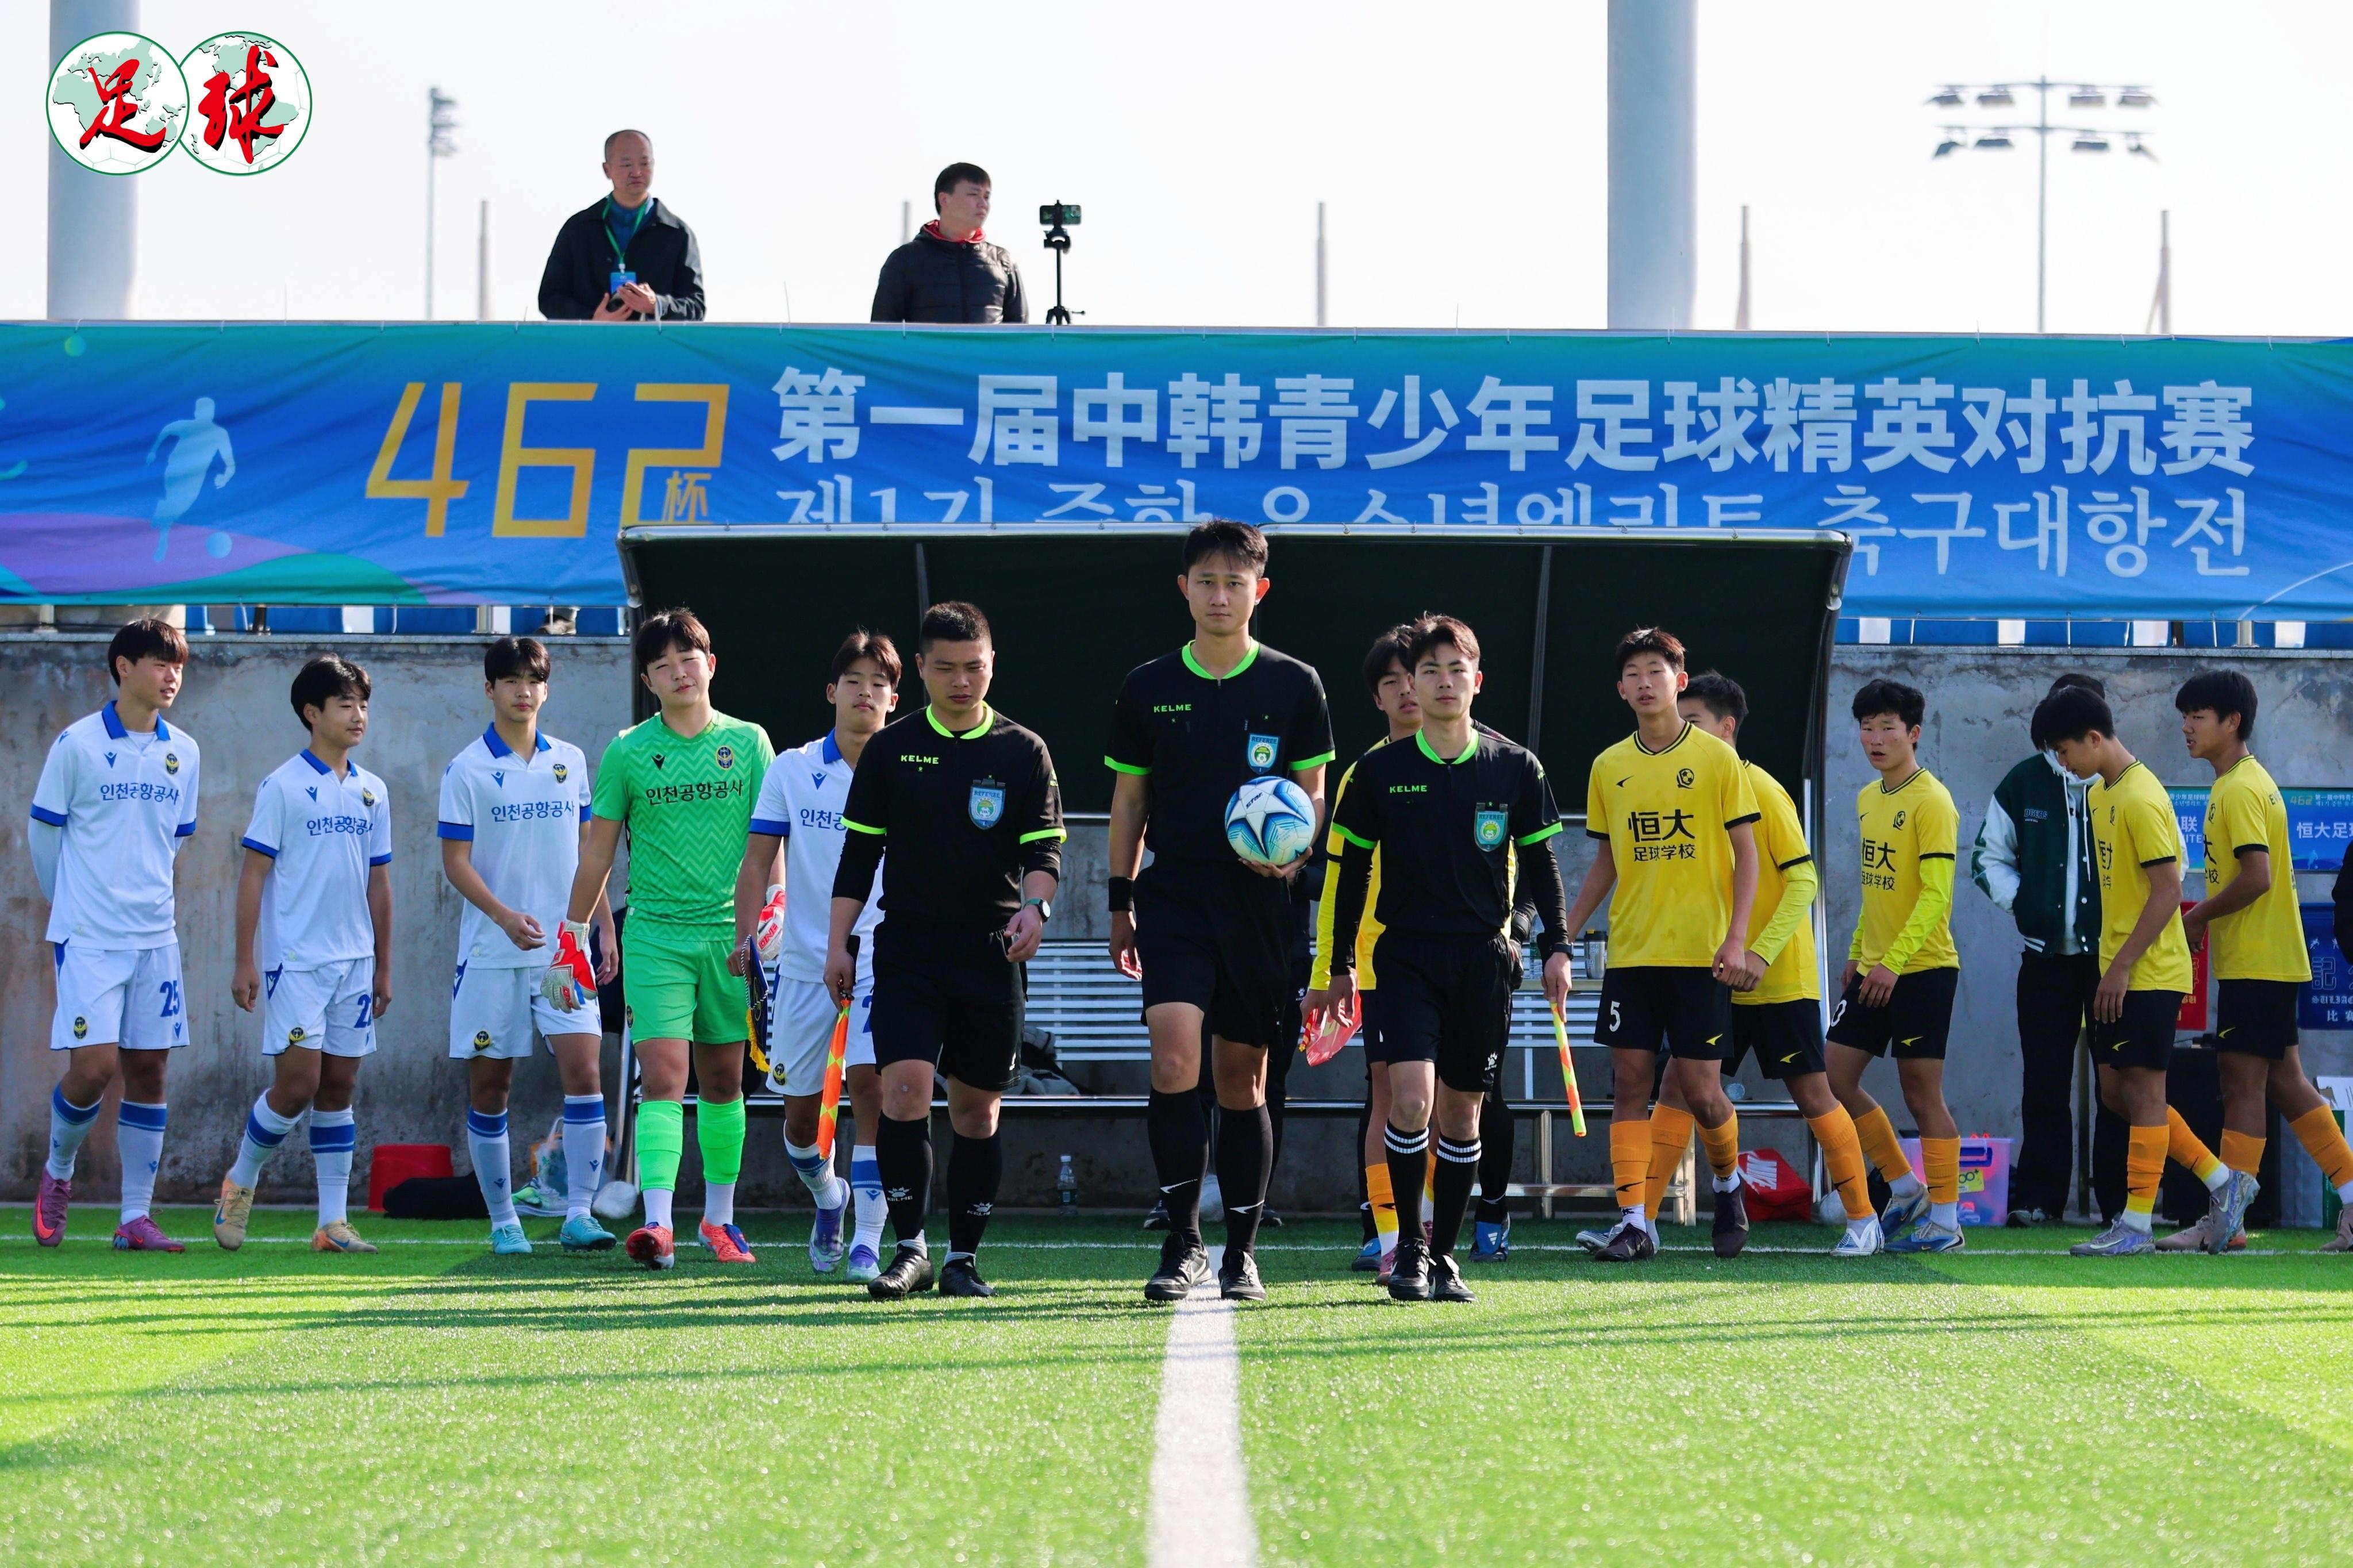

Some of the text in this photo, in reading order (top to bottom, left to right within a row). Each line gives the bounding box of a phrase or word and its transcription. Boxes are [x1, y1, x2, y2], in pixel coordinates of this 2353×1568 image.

[771, 366, 2255, 477] 第一届中韩青少年足球精英对抗赛
[366, 383, 730, 539] 462
[1154, 704, 1191, 713] KELME
[901, 754, 939, 764] KELME
[100, 782, 179, 805] 인천공항공사
[645, 779, 743, 805] 인천공항공사
[1389, 785, 1427, 794] KELME
[491, 800, 575, 823] 인천공항공사
[1628, 809, 1695, 843] 恒大
[1633, 843, 1697, 862] 足球学校
[1862, 837, 1896, 873] 恒大
[759, 923, 779, 950] ONE
[160, 980, 180, 1018] 25
[1609, 1000, 1621, 1032] 5
